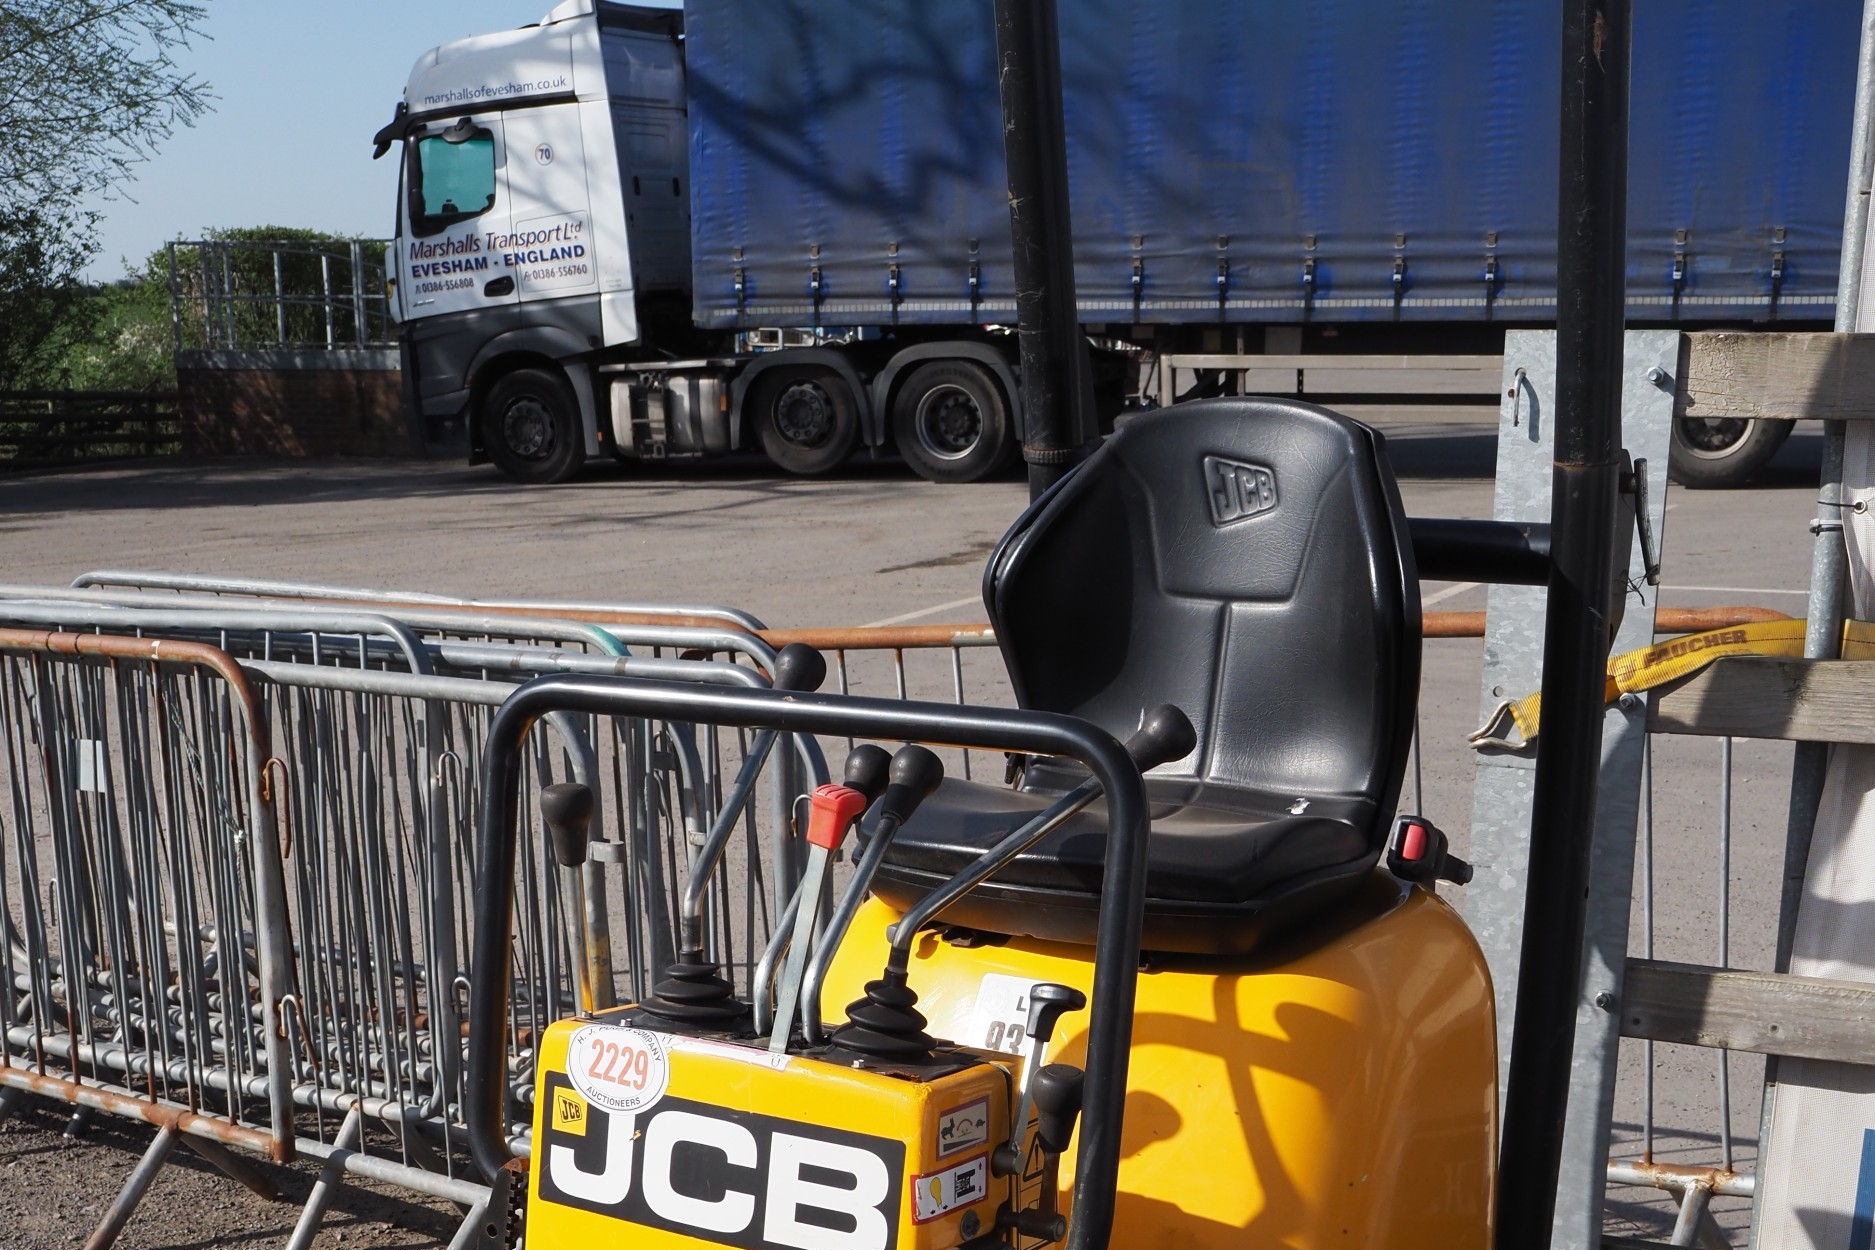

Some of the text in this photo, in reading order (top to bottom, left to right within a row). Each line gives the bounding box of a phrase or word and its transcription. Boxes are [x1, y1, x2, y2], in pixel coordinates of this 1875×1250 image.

[424, 75, 566, 105] marshallsofevesham.co.uk
[539, 148, 550, 160] 70
[409, 233, 481, 262] Marshalls
[486, 226, 561, 250] Transport
[411, 256, 488, 279] EVESHAM
[504, 244, 586, 268] ENGLAND
[1214, 462, 1273, 520] JCB
[633, 1029, 662, 1061] COMPANY
[588, 1038, 649, 1091] 2229
[561, 1099, 581, 1120] JCB
[586, 1086, 641, 1108] AUCTIONEERS
